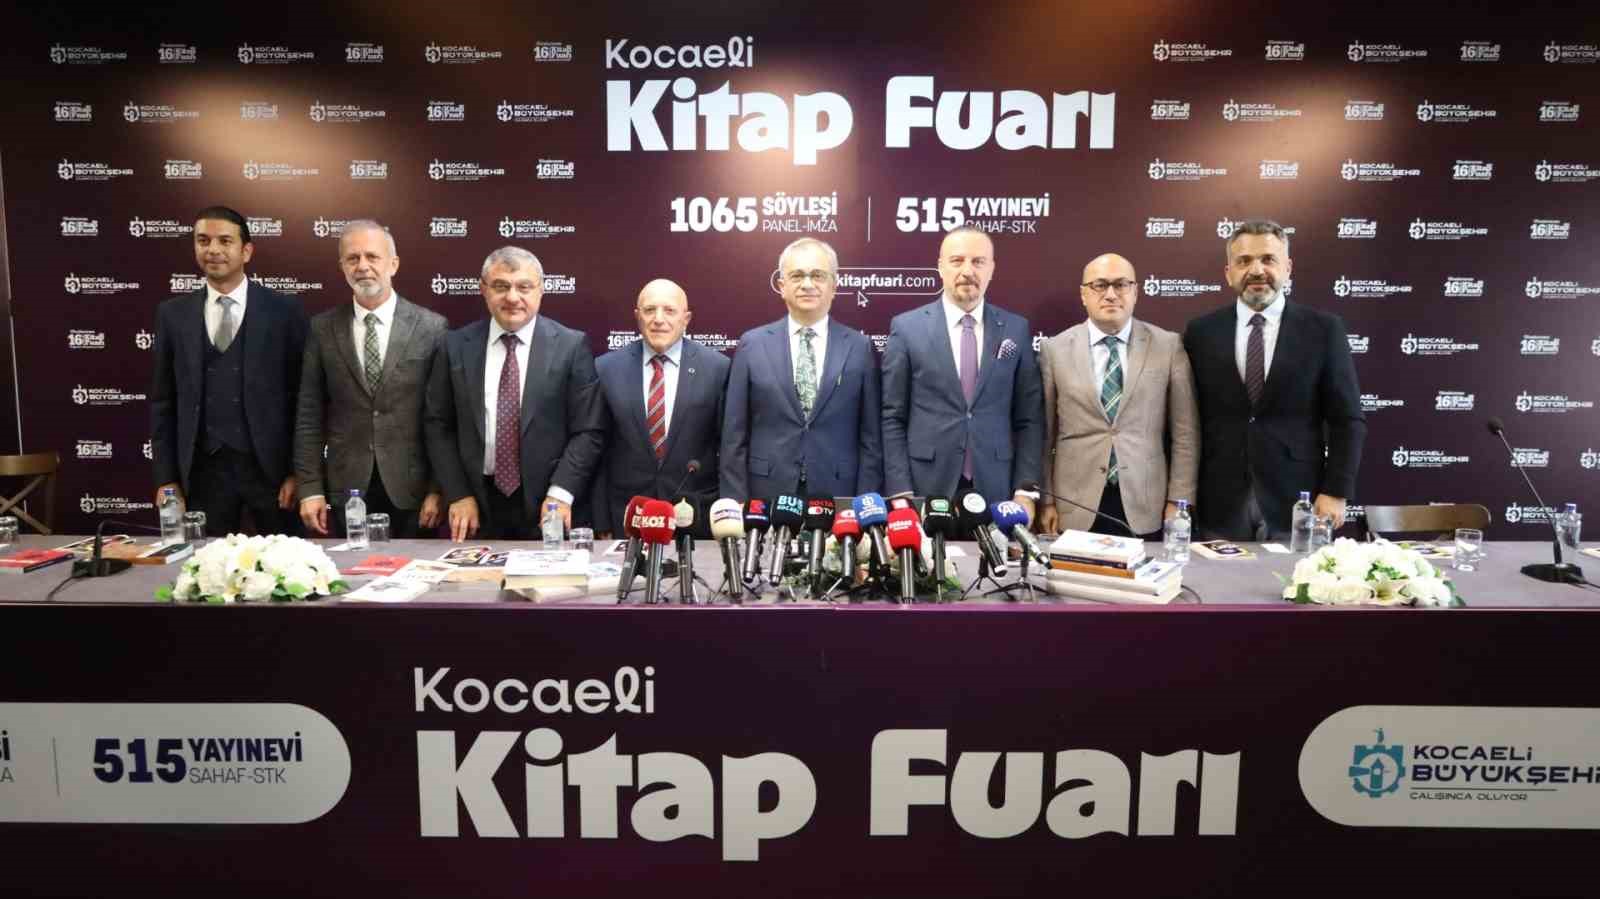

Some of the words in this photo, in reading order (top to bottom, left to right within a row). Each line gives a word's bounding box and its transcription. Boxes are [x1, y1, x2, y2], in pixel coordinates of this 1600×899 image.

[605, 36, 754, 68] Kocaeli
[606, 77, 853, 166] Kitap
[885, 76, 1116, 150] Fuarı
[670, 197, 758, 232] 1065
[762, 192, 838, 218] SÖYLEŞİ
[896, 198, 964, 232] 515
[965, 192, 1050, 216] YAYINEVİ
[762, 218, 838, 232] PANEL-İMZA
[414, 666, 655, 714] Kocaeli
[93, 738, 187, 783] 515
[188, 731, 302, 762] YAYINEVİ
[190, 767, 286, 784] SAHAF-STK
[416, 727, 817, 861] Kitap
[870, 728, 1241, 839] Fuarı
